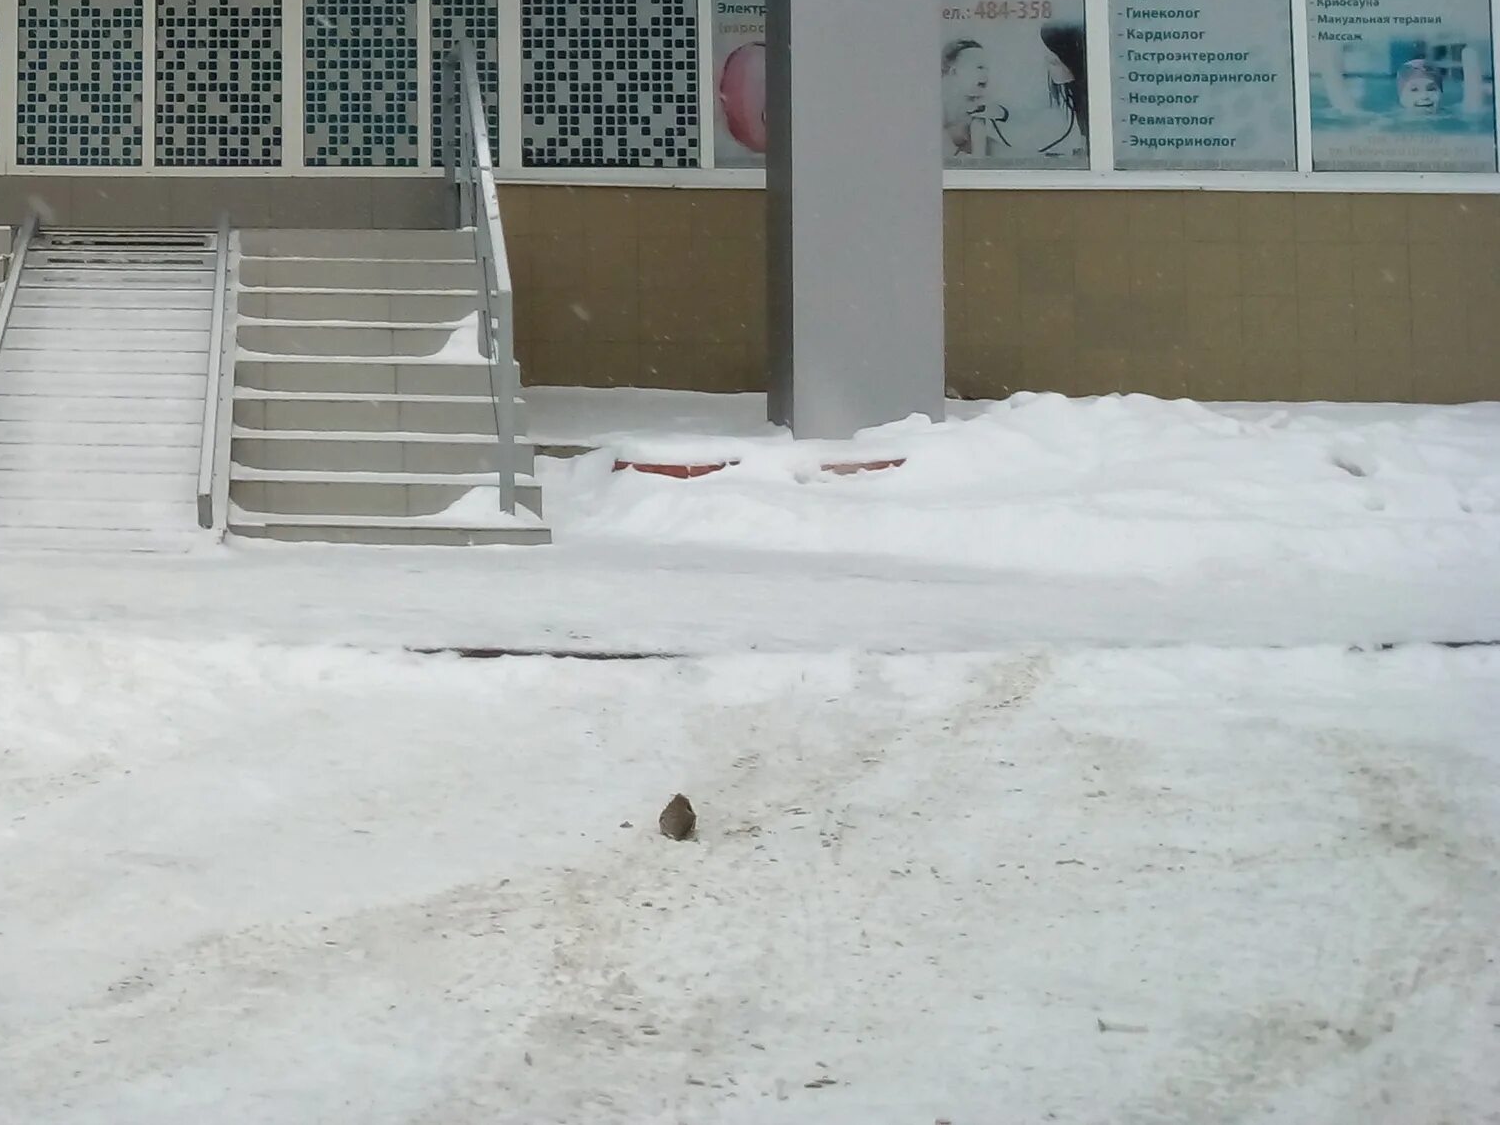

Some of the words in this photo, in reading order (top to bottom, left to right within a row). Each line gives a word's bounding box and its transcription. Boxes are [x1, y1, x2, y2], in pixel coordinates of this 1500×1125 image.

[717, 1, 768, 16] Электр
[942, 6, 971, 20] ел.:
[974, 0, 1053, 20] 484-358
[1125, 7, 1201, 19] Гинеколог
[1126, 28, 1206, 42] Кардиолог
[1317, 31, 1363, 42] Массаж
[1127, 49, 1250, 64] Гастроэнтеролог
[1128, 71, 1278, 84] Оториноларинголог
[1128, 92, 1200, 106] Невролог
[1129, 113, 1215, 126] Ревматолог
[1129, 135, 1237, 149] Эндокринолог
